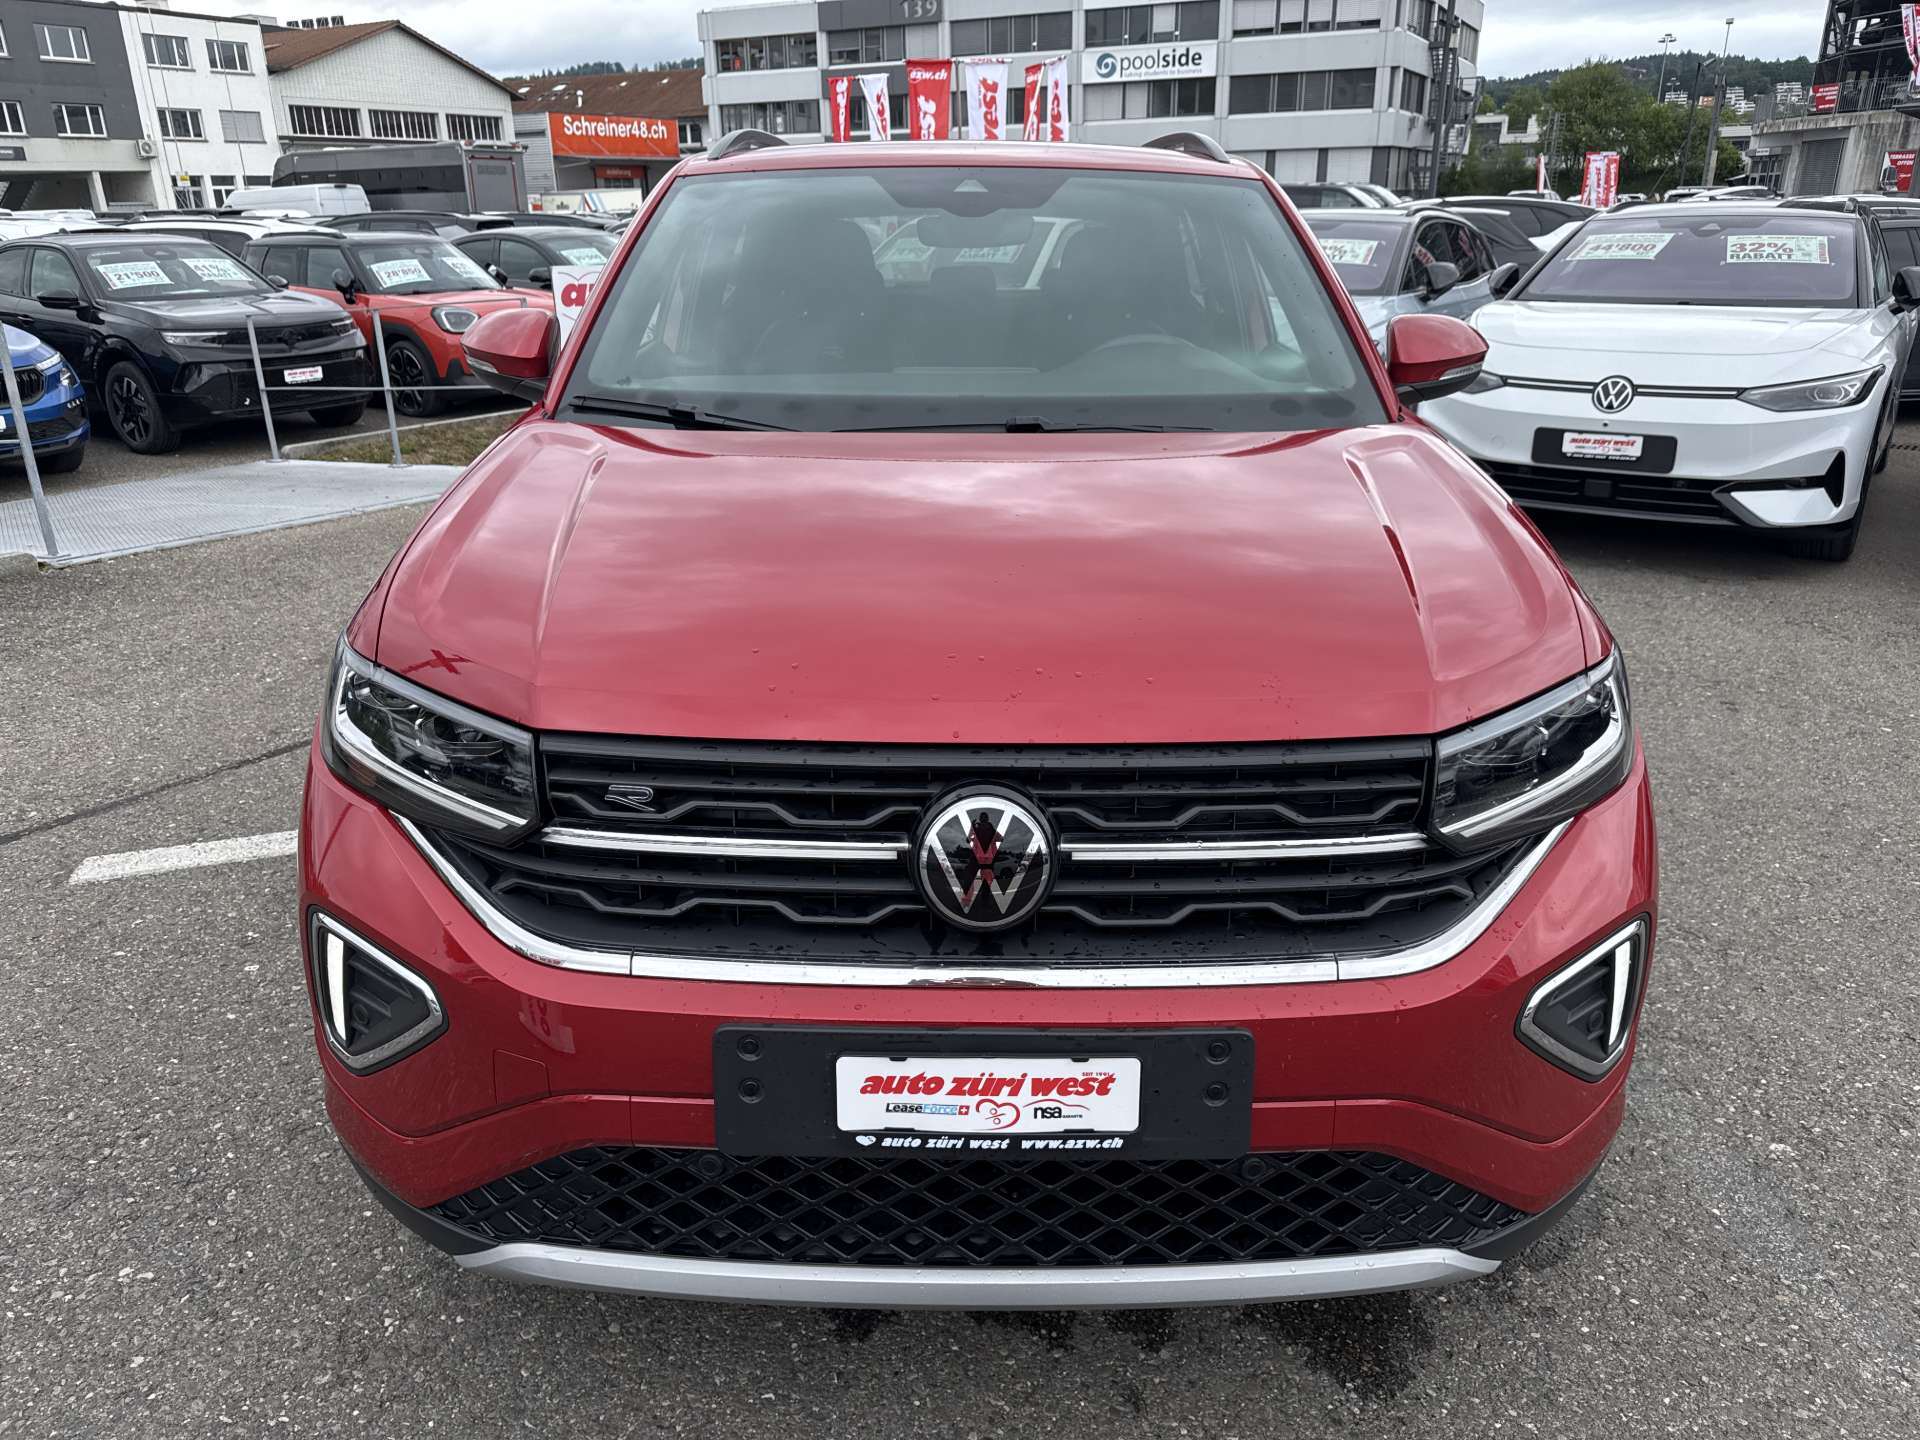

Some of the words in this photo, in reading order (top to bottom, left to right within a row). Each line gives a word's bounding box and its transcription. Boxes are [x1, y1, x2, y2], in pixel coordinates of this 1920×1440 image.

[902, 0, 937, 18] 139
[1120, 48, 1202, 78] poolside
[563, 115, 667, 139] Schreiner48.ch
[1730, 242, 1793, 253] 32%
[1729, 252, 1793, 260] RABATT
[114, 270, 160, 281] 21'500
[920, 797, 1050, 927] VW
[860, 1072, 944, 1095] auto
[945, 1072, 1028, 1096] züri
[1031, 1073, 1116, 1096] west
[886, 1103, 957, 1115] LeaseForce
[1034, 1107, 1062, 1119] nsa
[881, 1136, 921, 1147] auto
[925, 1136, 964, 1149] züri
[969, 1138, 1010, 1149] west
[1021, 1137, 1124, 1149] www.azw.ch
